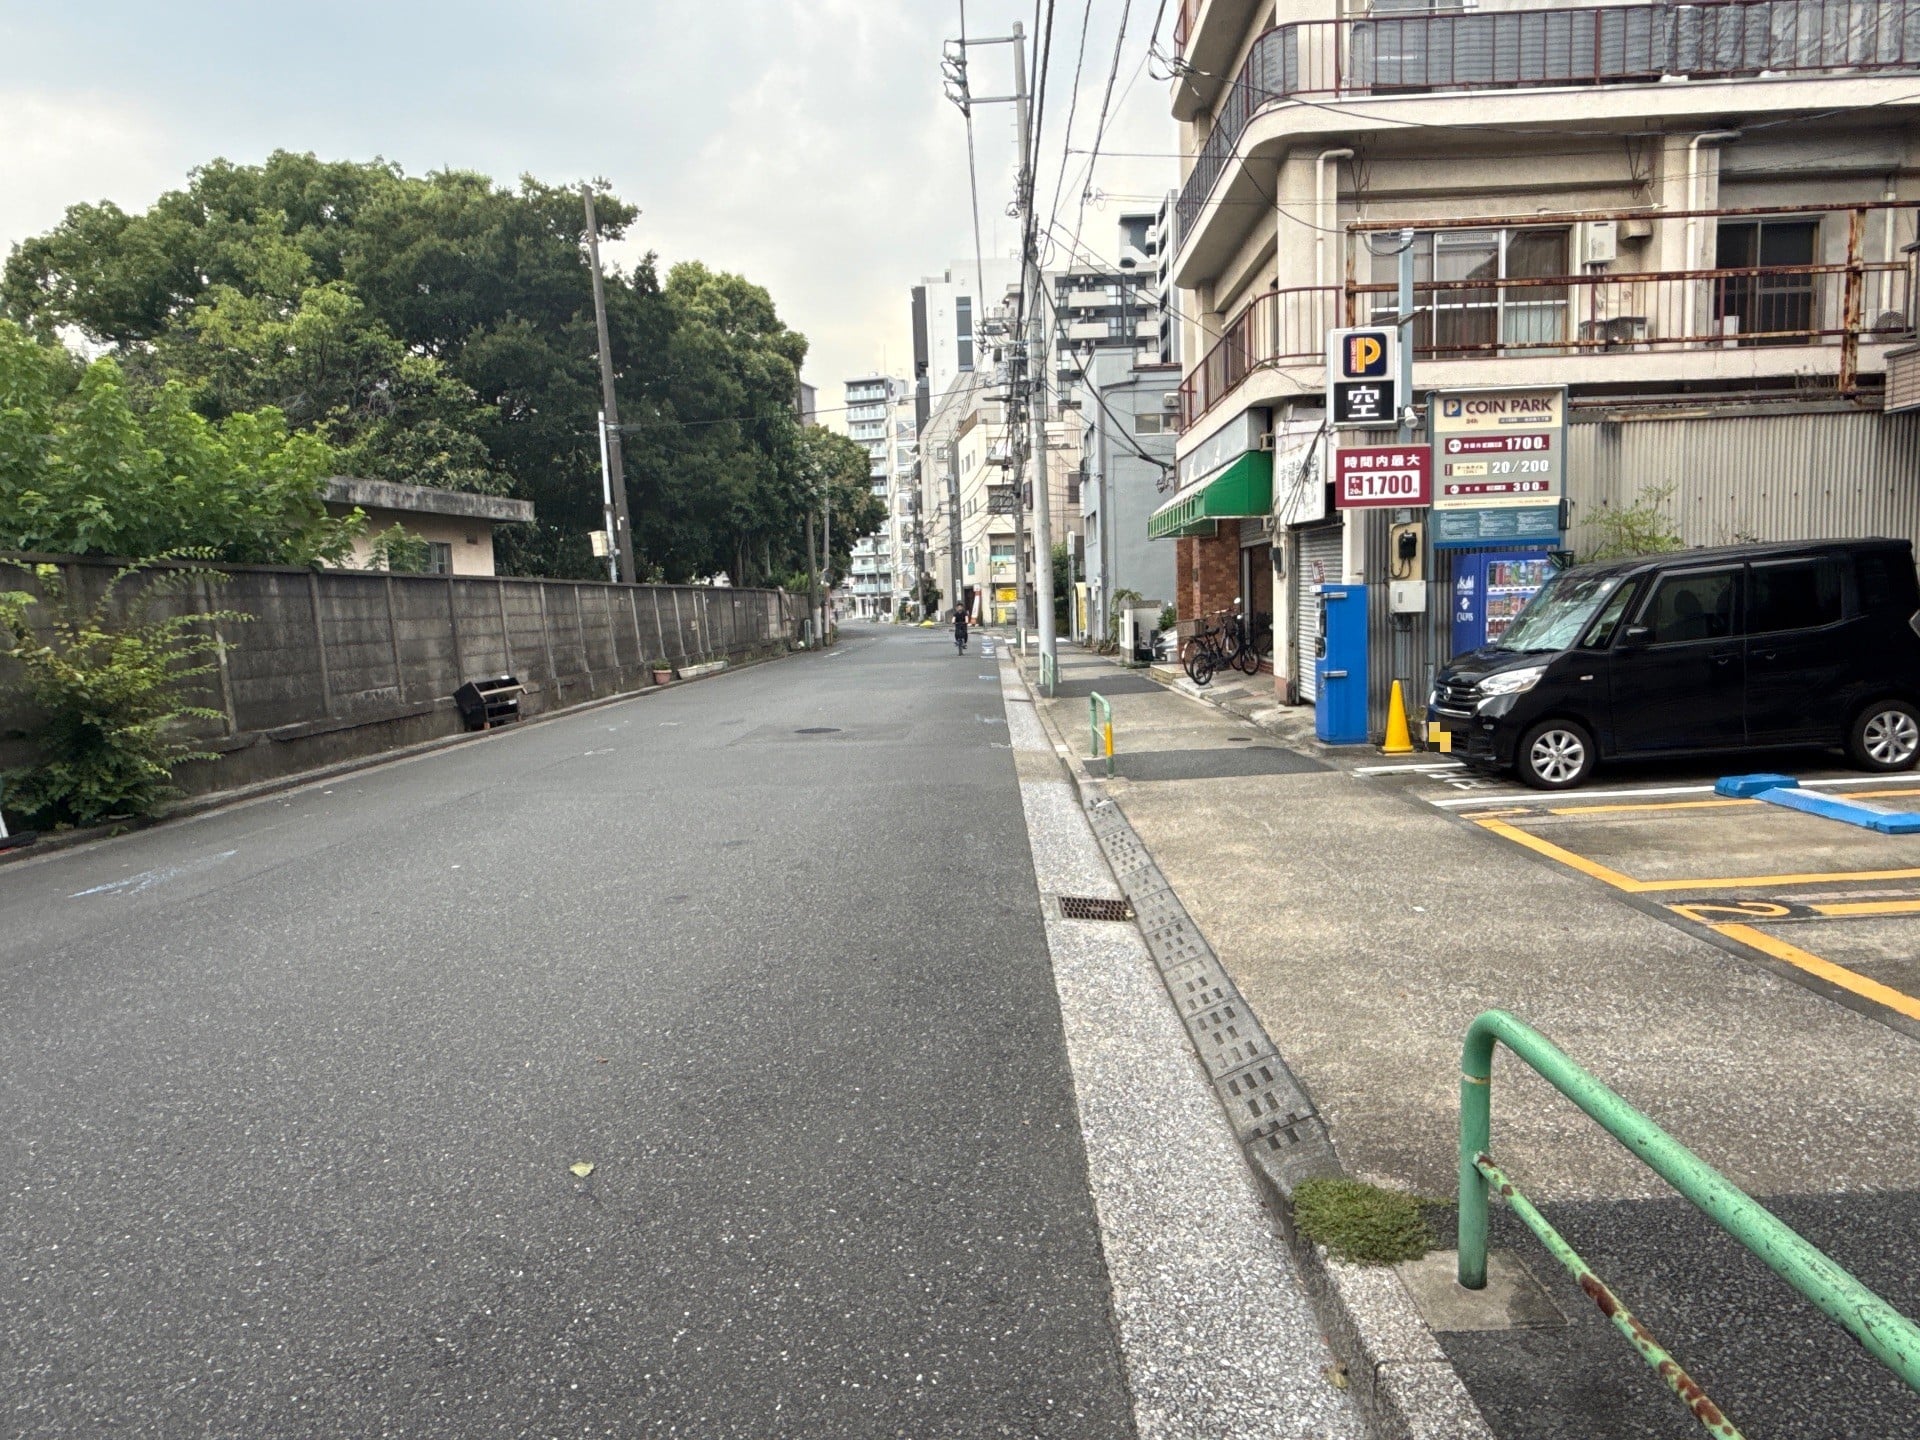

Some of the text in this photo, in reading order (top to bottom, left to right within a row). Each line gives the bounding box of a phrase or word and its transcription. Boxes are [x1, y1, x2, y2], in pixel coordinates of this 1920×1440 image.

[1348, 386, 1379, 418] 空
[1466, 399, 1552, 414] COIN PARK
[1344, 454, 1420, 468] 時間内最大
[1492, 460, 1549, 473] 20/200
